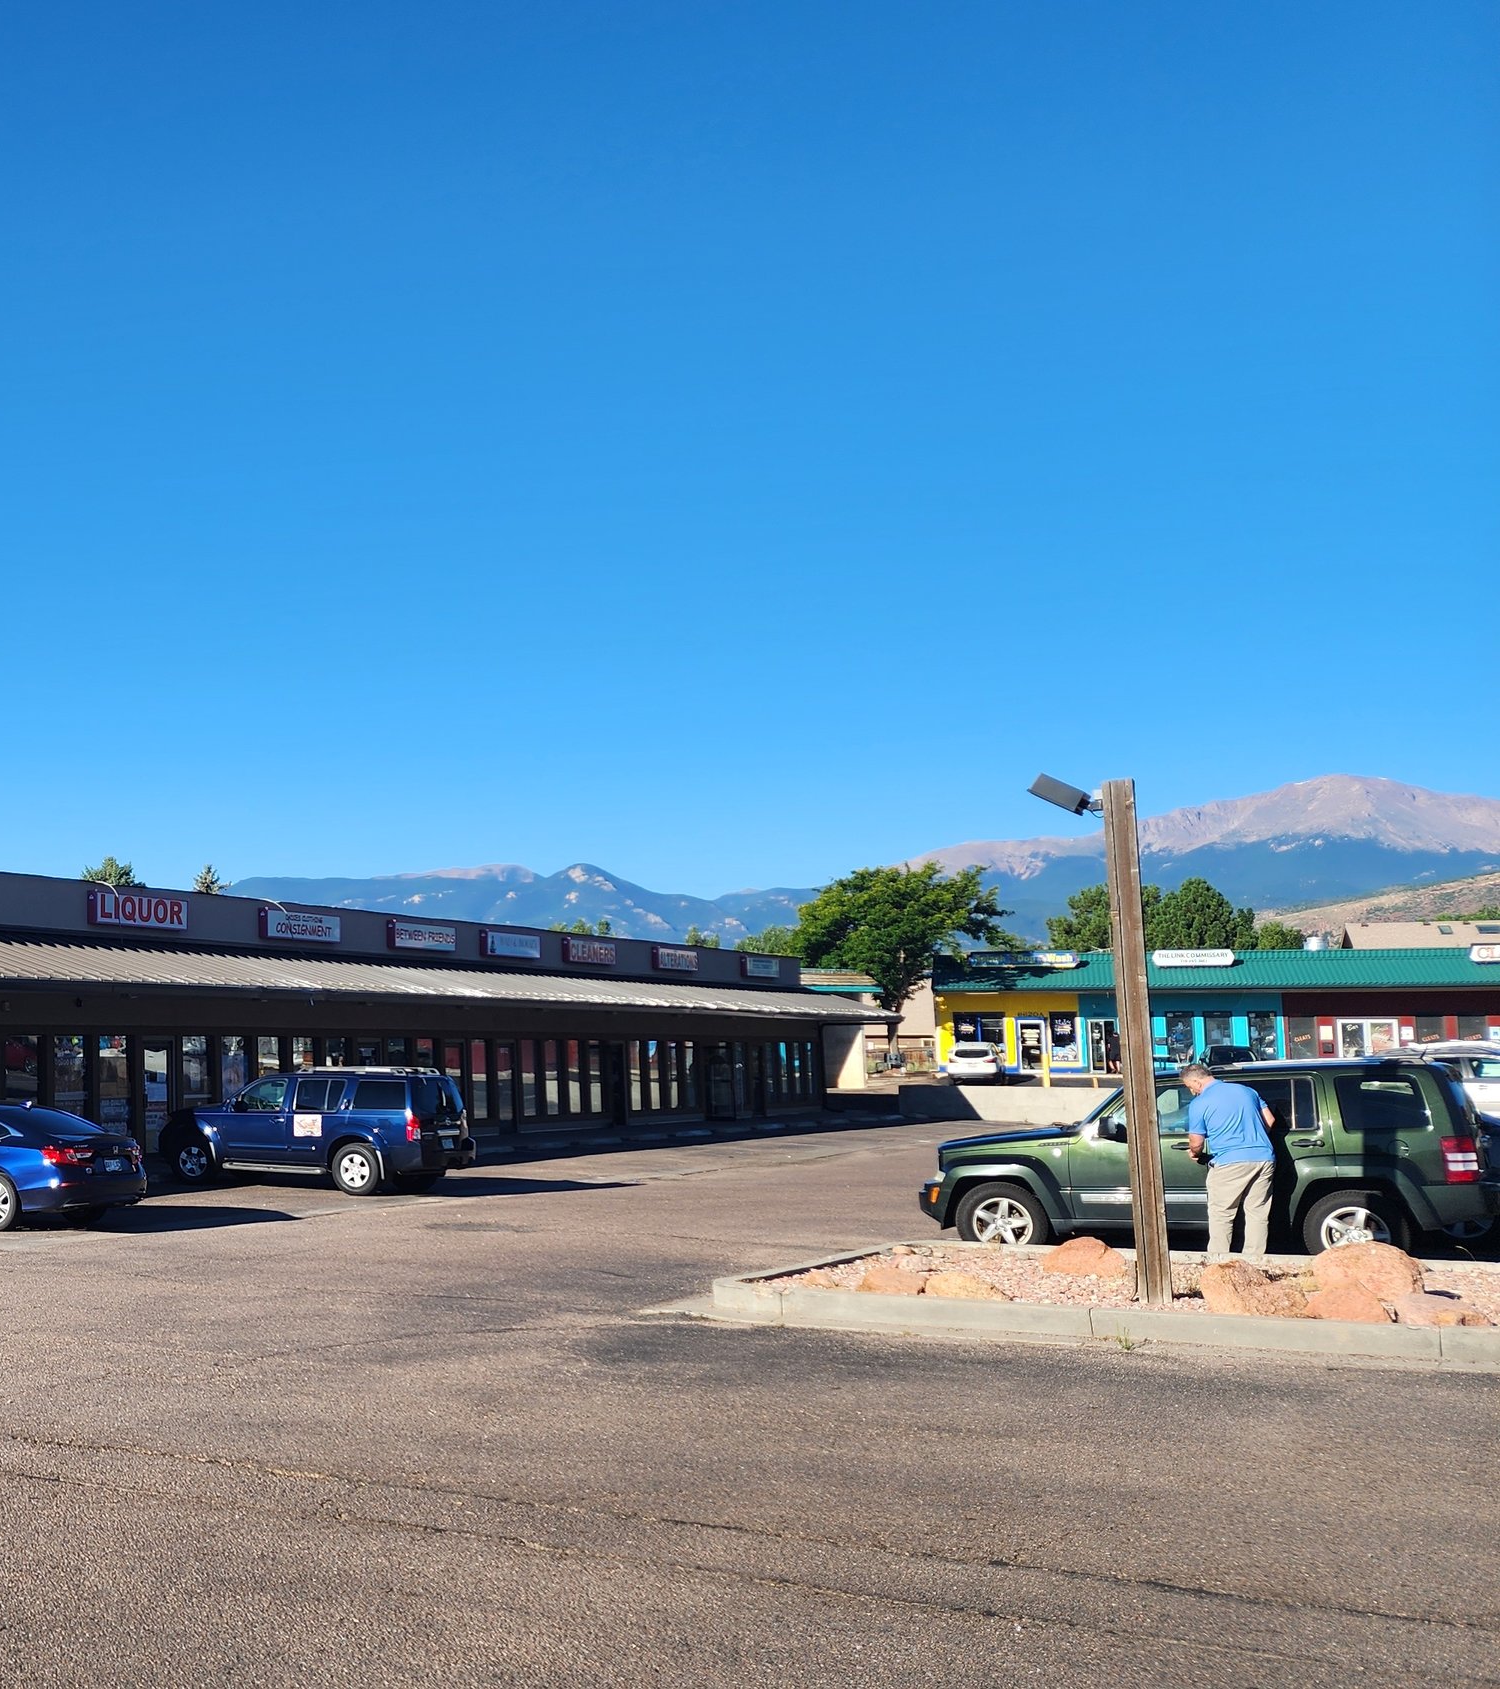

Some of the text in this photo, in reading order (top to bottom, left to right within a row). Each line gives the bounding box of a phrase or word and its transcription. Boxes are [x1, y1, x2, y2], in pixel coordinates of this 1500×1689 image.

[100, 893, 183, 925] LIQUOR
[276, 922, 332, 938] CONSIGNMENT
[396, 928, 456, 944] BETWEEN FRIENDS
[571, 943, 614, 963] CLEANERS
[660, 951, 698, 969] ALTERATIONS
[1018, 954, 1037, 964] Dog
[1049, 953, 1074, 963] Wash
[1294, 1034, 1311, 1042] CLEATS
[1421, 1034, 1440, 1042] CLEATS
